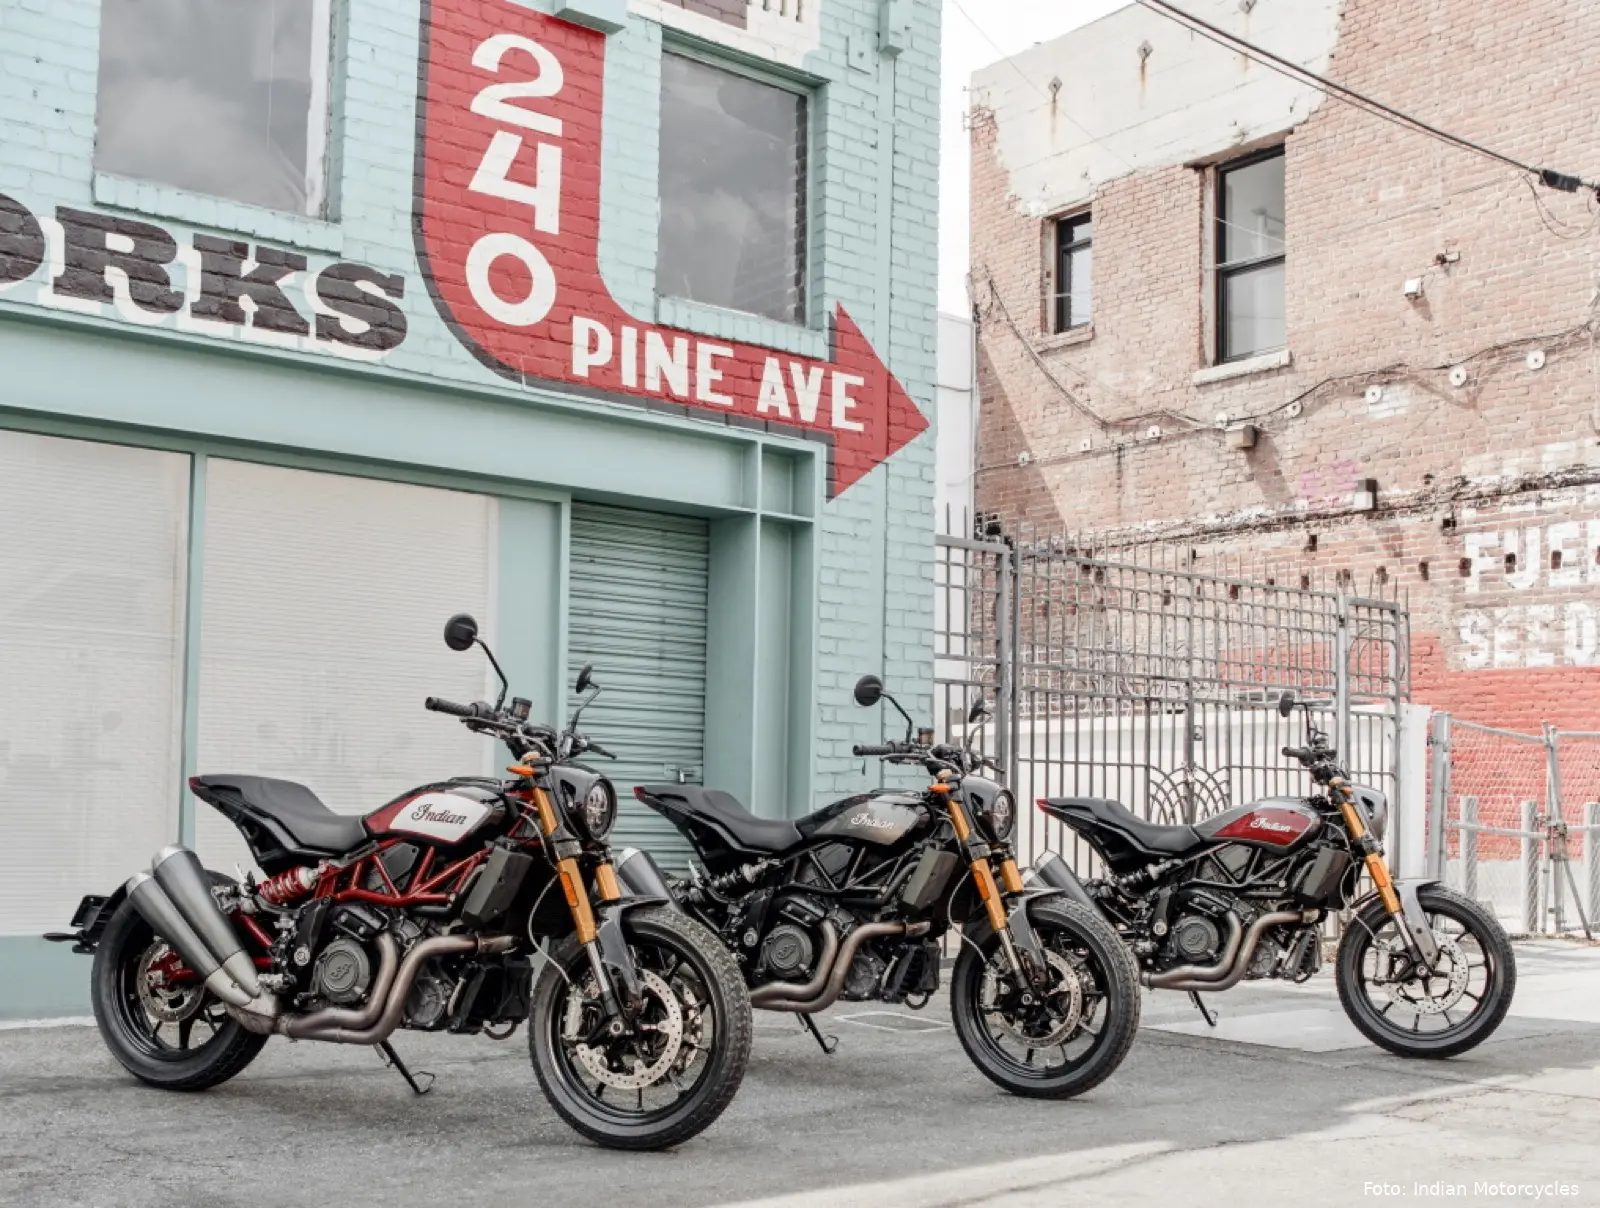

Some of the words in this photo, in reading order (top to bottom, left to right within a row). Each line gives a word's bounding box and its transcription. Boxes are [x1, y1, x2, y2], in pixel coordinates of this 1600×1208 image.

[465, 34, 564, 326] 240
[571, 315, 734, 406] PINE
[756, 356, 865, 432] AVE
[411, 803, 468, 825] Indian
[851, 812, 895, 830] Indan
